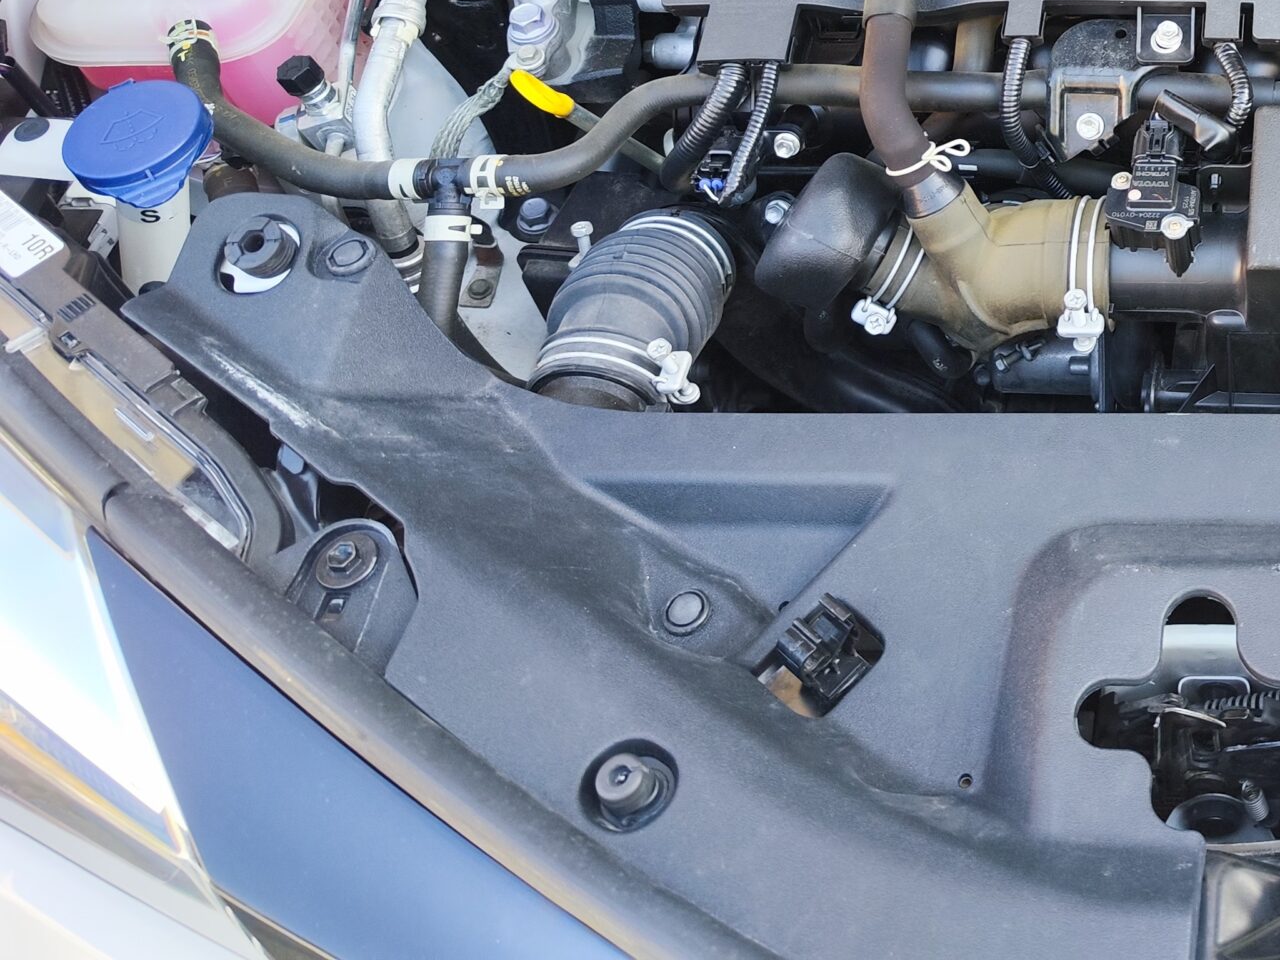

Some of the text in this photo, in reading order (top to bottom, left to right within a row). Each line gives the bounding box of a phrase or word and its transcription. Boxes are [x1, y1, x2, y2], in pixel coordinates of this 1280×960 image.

[1132, 180, 1170, 188] TOYOTA
[140, 209, 161, 224] S
[22, 233, 55, 260] 10R
